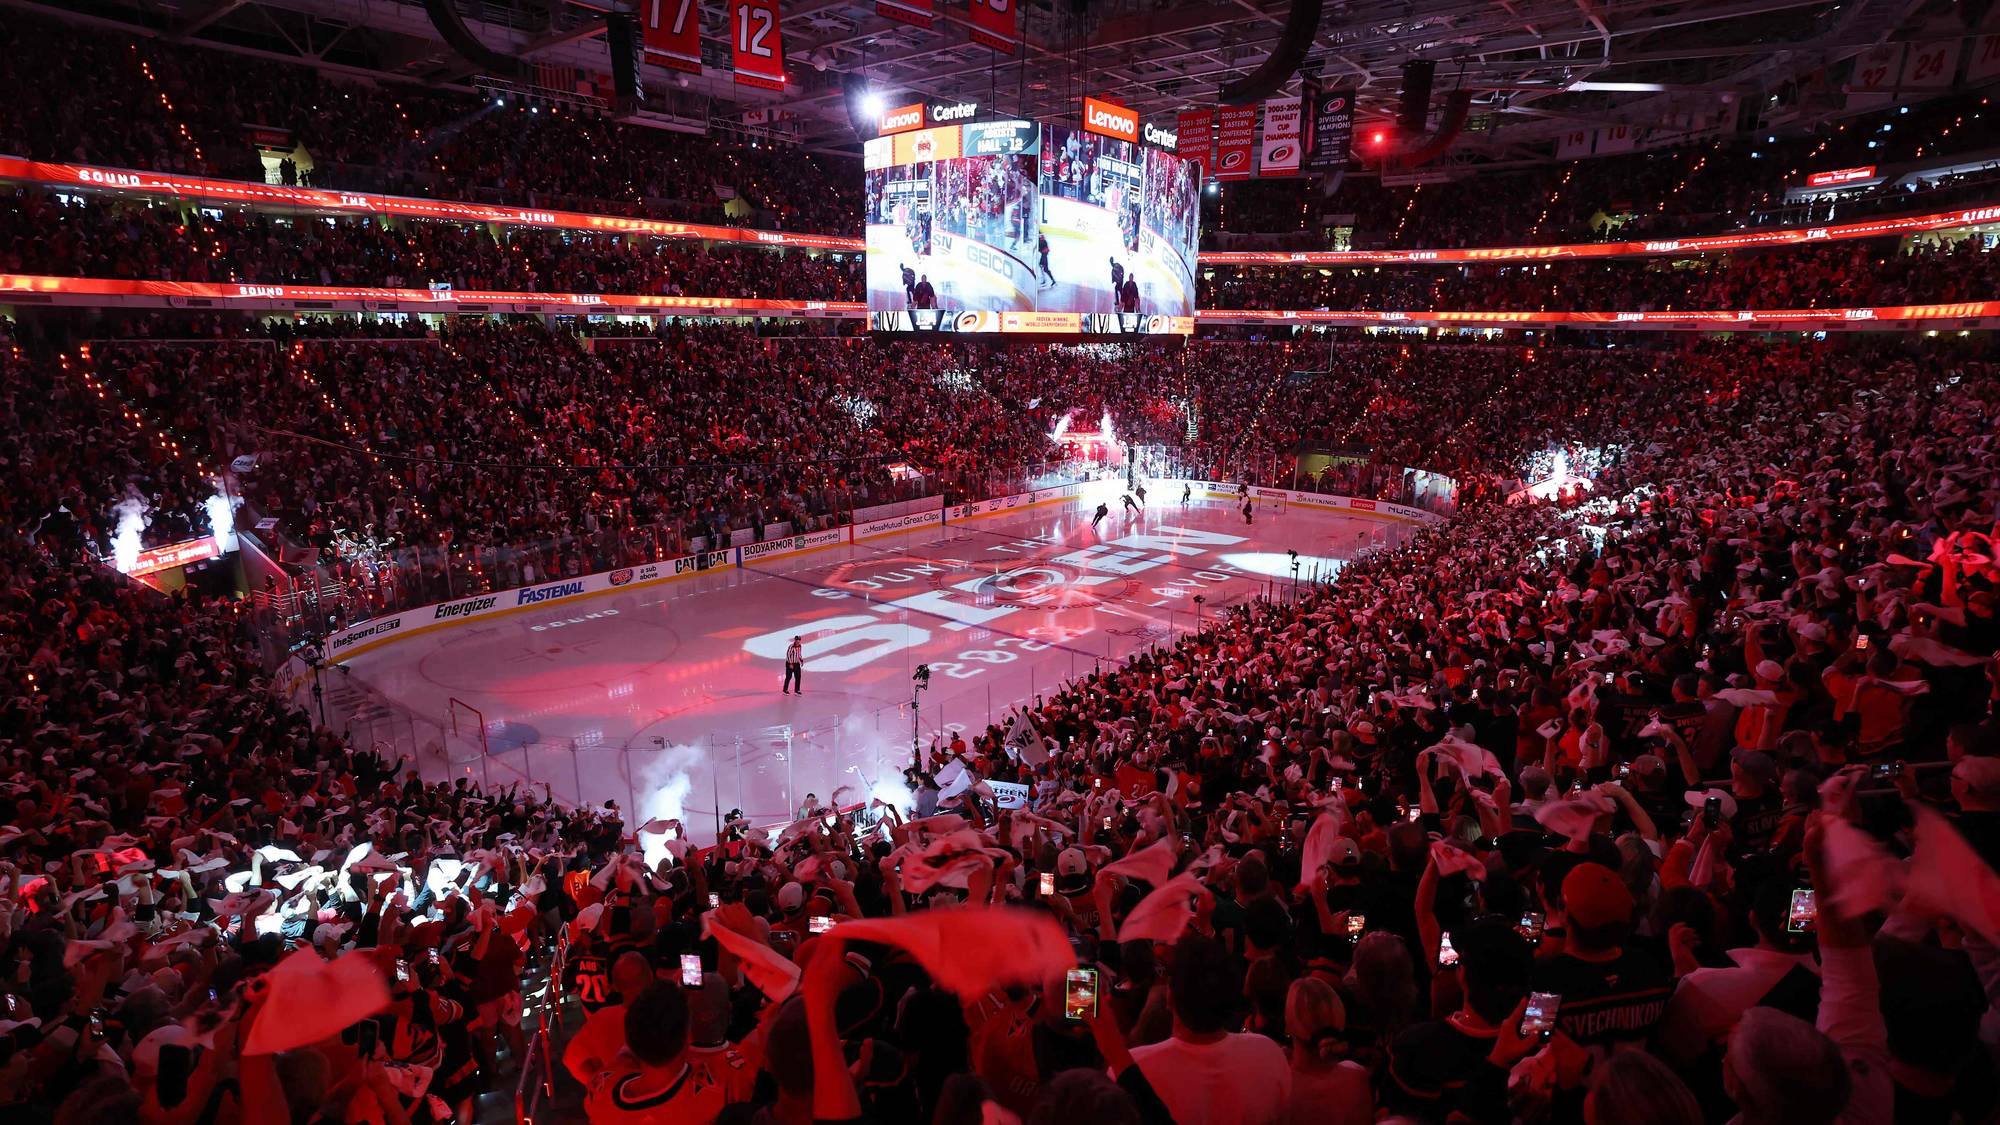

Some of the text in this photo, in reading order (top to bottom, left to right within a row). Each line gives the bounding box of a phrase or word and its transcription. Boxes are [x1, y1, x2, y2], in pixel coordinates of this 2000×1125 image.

[650, 0, 690, 34] 17
[738, 4, 773, 57] 12
[882, 103, 977, 130] Lenovo Center
[1224, 120, 1249, 128] EASTERN
[1271, 113, 1298, 122] STANLEY
[1319, 114, 1349, 124] DIVISION
[1088, 104, 1178, 149] Lenovo Center
[1183, 127, 1206, 136] EASTERN
[1219, 128, 1252, 138] CONFERENCE
[1277, 123, 1290, 131] CUP
[1179, 136, 1209, 145] CONFERENCE
[1219, 138, 1251, 146] CHAMPIONS
[1265, 132, 1301, 141] CHAMPIONS
[918, 141, 931, 150] BBQ
[977, 138, 1024, 153] HALL 12
[1178, 144, 1210, 153] CHAMPIONS
[79, 170, 555, 223] SOUND THE SIREN
[758, 233, 784, 242] SOUND
[1646, 208, 2000, 251] SOUND THE SIREN
[967, 245, 1013, 280] GEICO
[1408, 252, 1437, 260] SIREN
[1162, 250, 1185, 282] GEICO
[240, 286, 601, 303] SOUND THE SIREN
[1738, 312, 1753, 320] THE
[1845, 309, 1874, 319] SIREN
[1352, 501, 1374, 509] Lenovo
[903, 512, 940, 525] Great Clips
[869, 520, 903, 534] MassMutual
[744, 539, 793, 556] BODYARMOR
[797, 533, 839, 547] enterprise
[675, 557, 696, 574] CAT
[709, 551, 729, 567] CAT
[811, 558, 970, 600] SOUND
[517, 581, 585, 605] FASTENAL
[1094, 562, 1244, 617] PLAYOF
[434, 597, 496, 619] Energizer
[530, 609, 620, 632] SOUND
[333, 619, 399, 649] theScore BET
[576, 974, 609, 1003] 20
[1561, 1000, 1665, 1038] SVECHNIKOV
